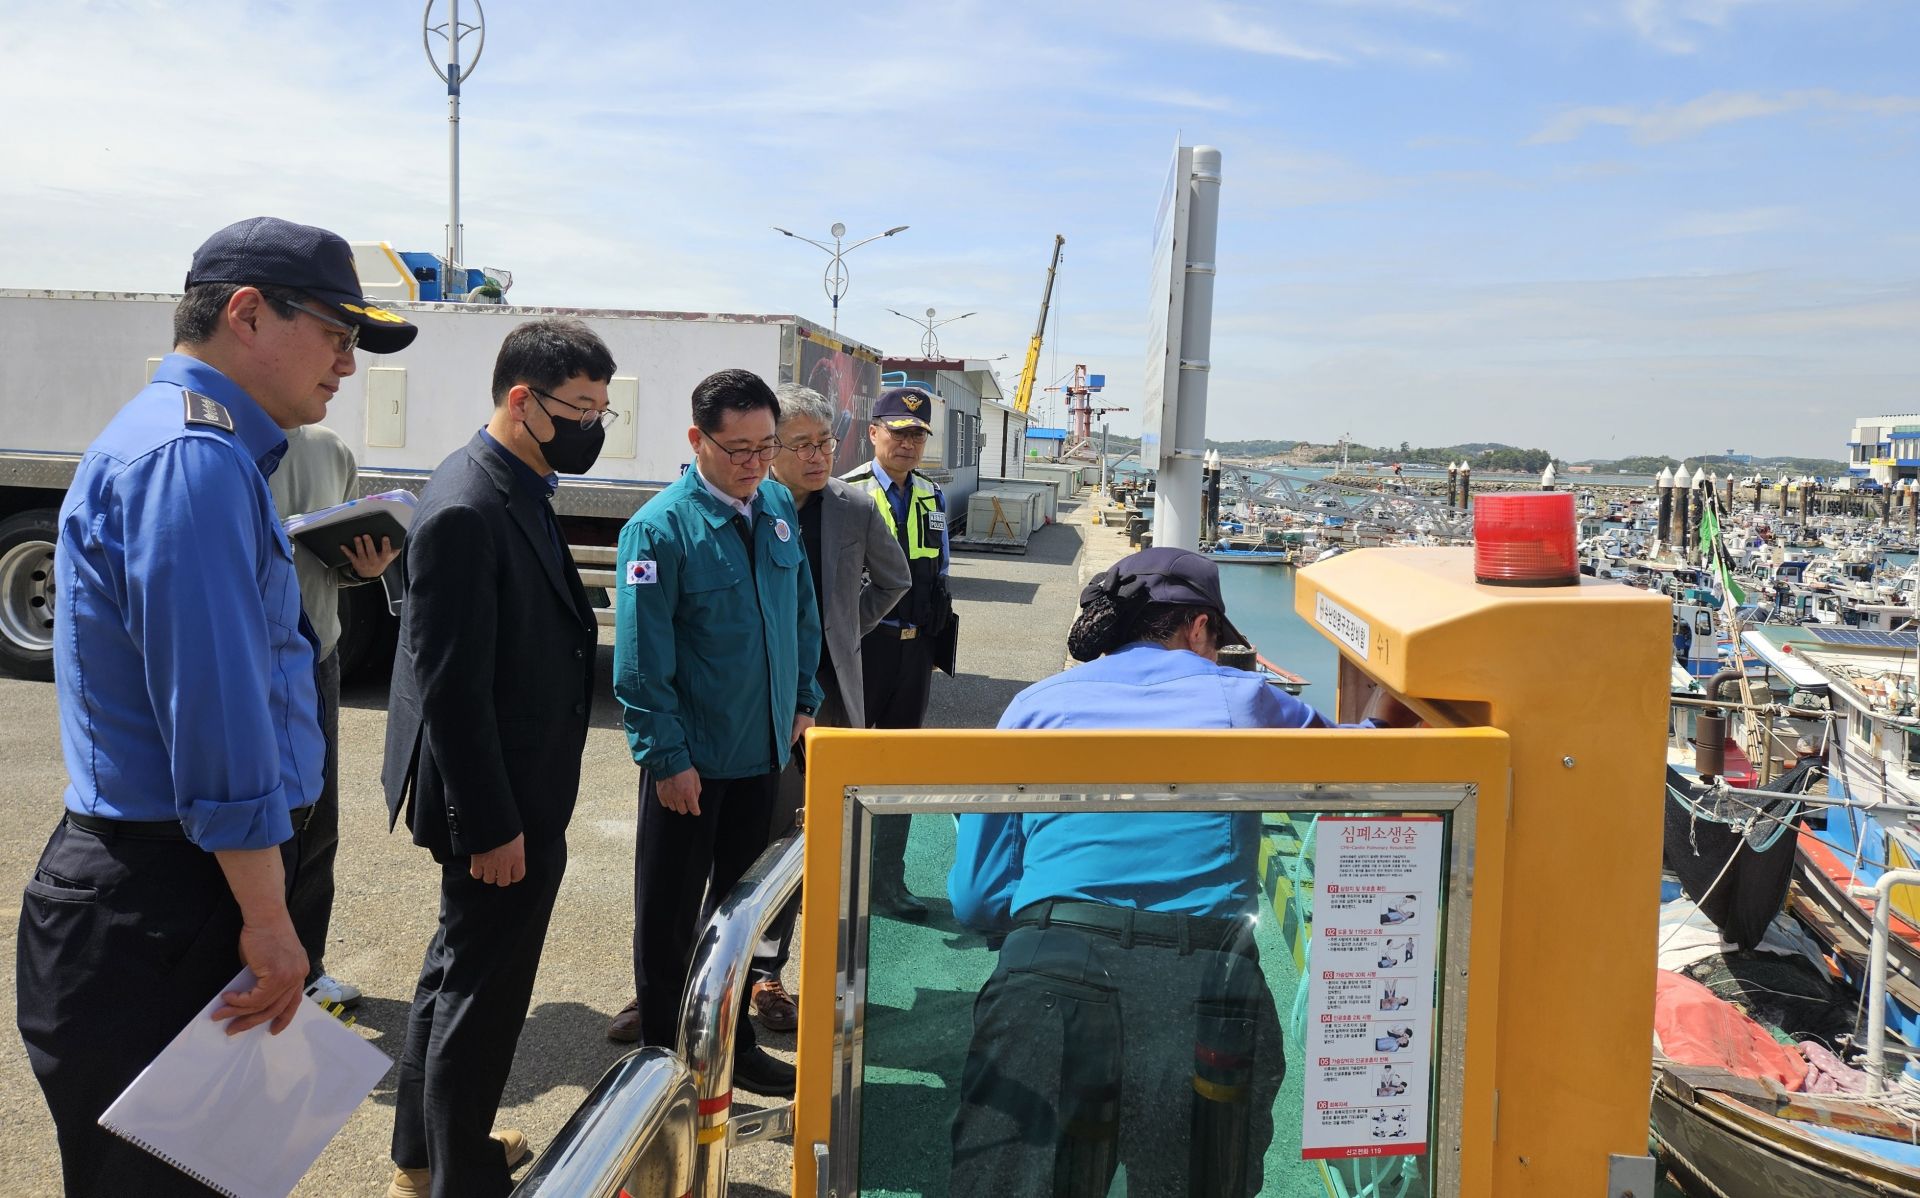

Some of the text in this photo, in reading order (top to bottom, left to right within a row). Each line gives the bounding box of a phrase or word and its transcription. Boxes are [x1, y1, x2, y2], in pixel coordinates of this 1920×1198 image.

[1341, 826, 1418, 844] 심폐소생술
[1329, 885, 1338, 893] 01
[1326, 928, 1336, 936] 02
[1324, 971, 1334, 979] 03
[1320, 1058, 1329, 1066] 05
[1318, 1101, 1328, 1109] 06
[1346, 1148, 1369, 1156] 신고전화
